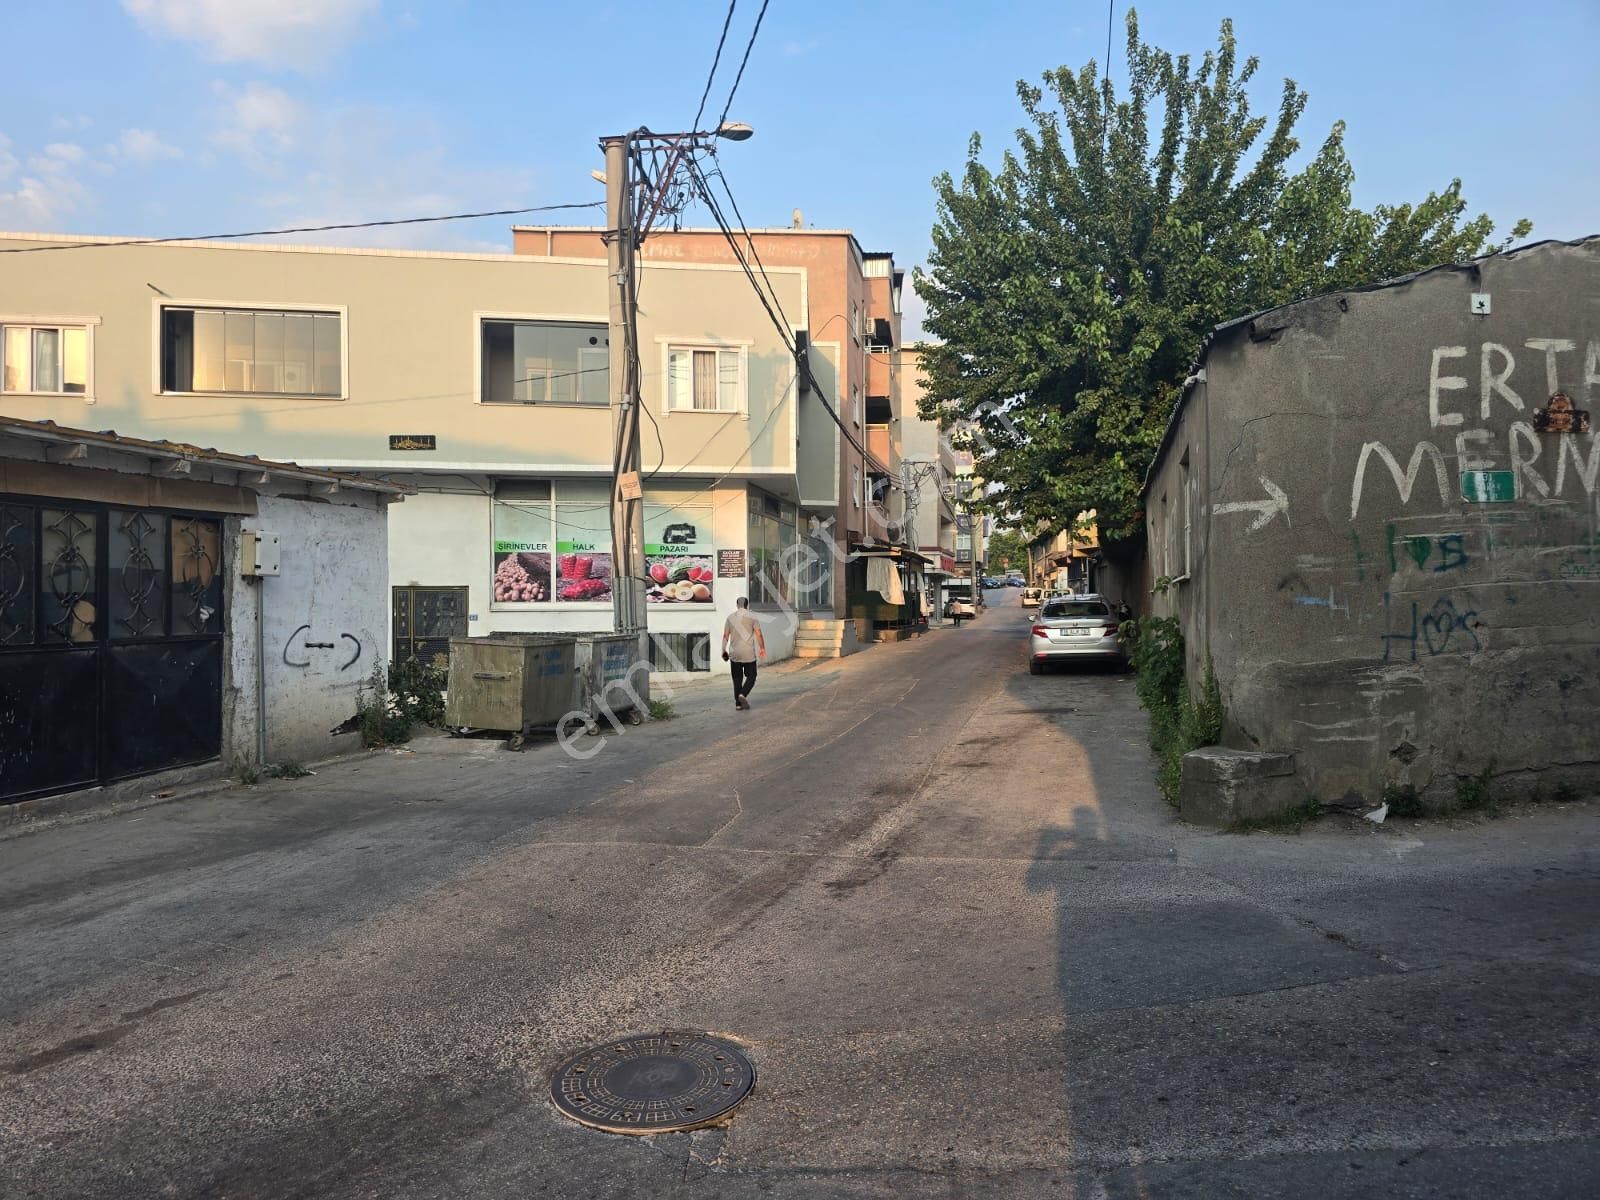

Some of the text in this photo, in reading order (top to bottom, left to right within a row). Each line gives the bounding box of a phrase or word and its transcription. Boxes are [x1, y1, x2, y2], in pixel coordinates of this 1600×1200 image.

[498, 541, 689, 553] ŞİRİNEVLER HALK PAZARI
